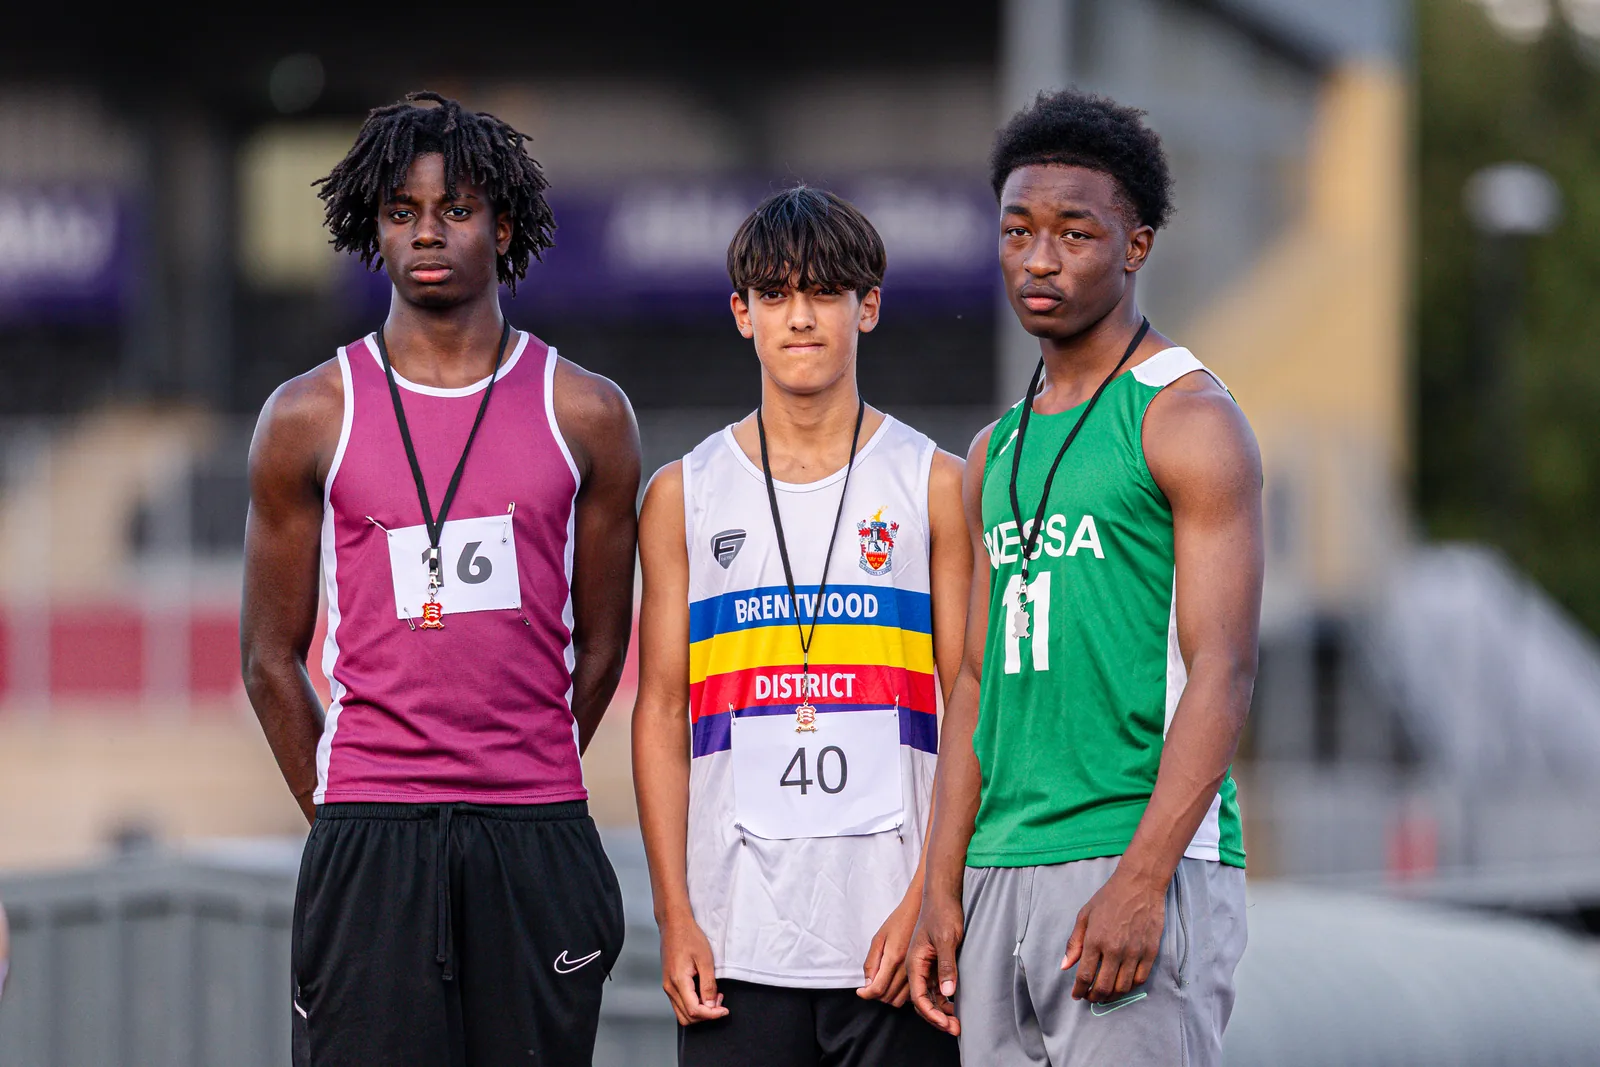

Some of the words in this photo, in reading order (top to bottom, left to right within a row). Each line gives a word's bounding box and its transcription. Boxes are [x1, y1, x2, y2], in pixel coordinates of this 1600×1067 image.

[422, 541, 492, 587] 16
[735, 592, 879, 624] BRENTWOOD
[1002, 571, 1051, 674] 11
[755, 673, 856, 699] DISTRICT
[780, 745, 848, 795] 40
